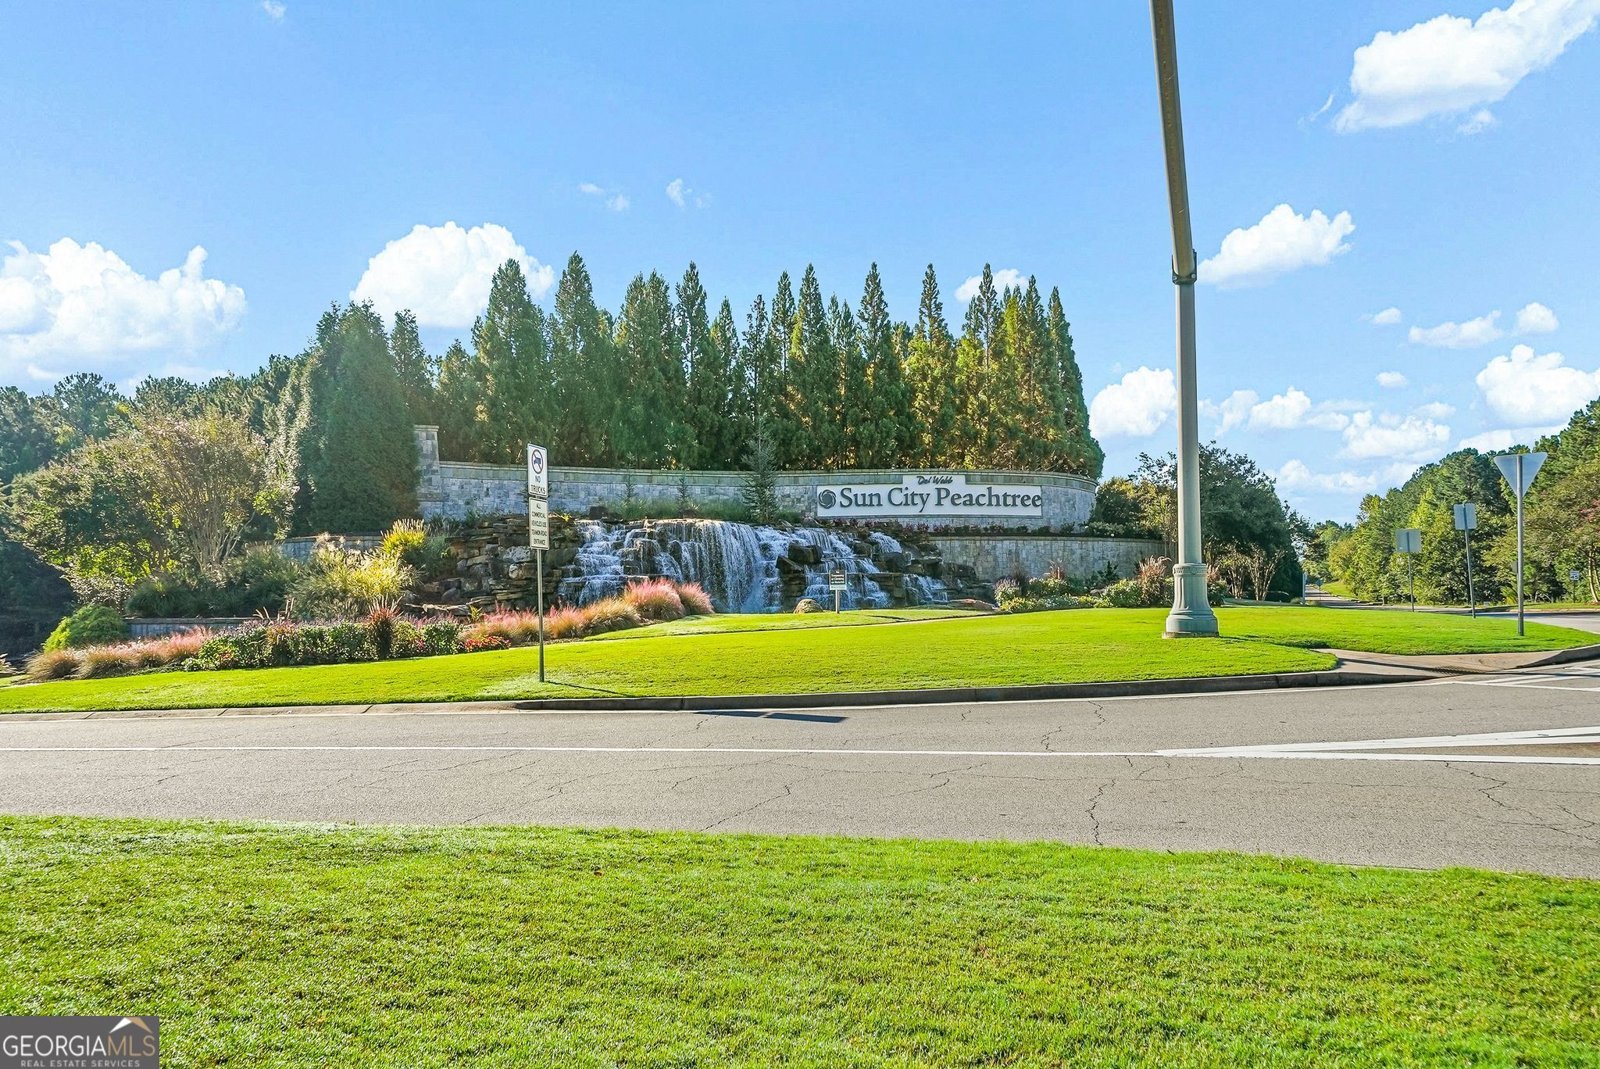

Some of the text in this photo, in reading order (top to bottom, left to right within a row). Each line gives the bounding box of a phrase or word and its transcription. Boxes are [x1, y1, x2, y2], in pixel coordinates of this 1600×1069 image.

[916, 475, 953, 485] Del Webb
[530, 484, 546, 494] TRUCKS
[839, 487, 1042, 513] Sun City Peachtree
